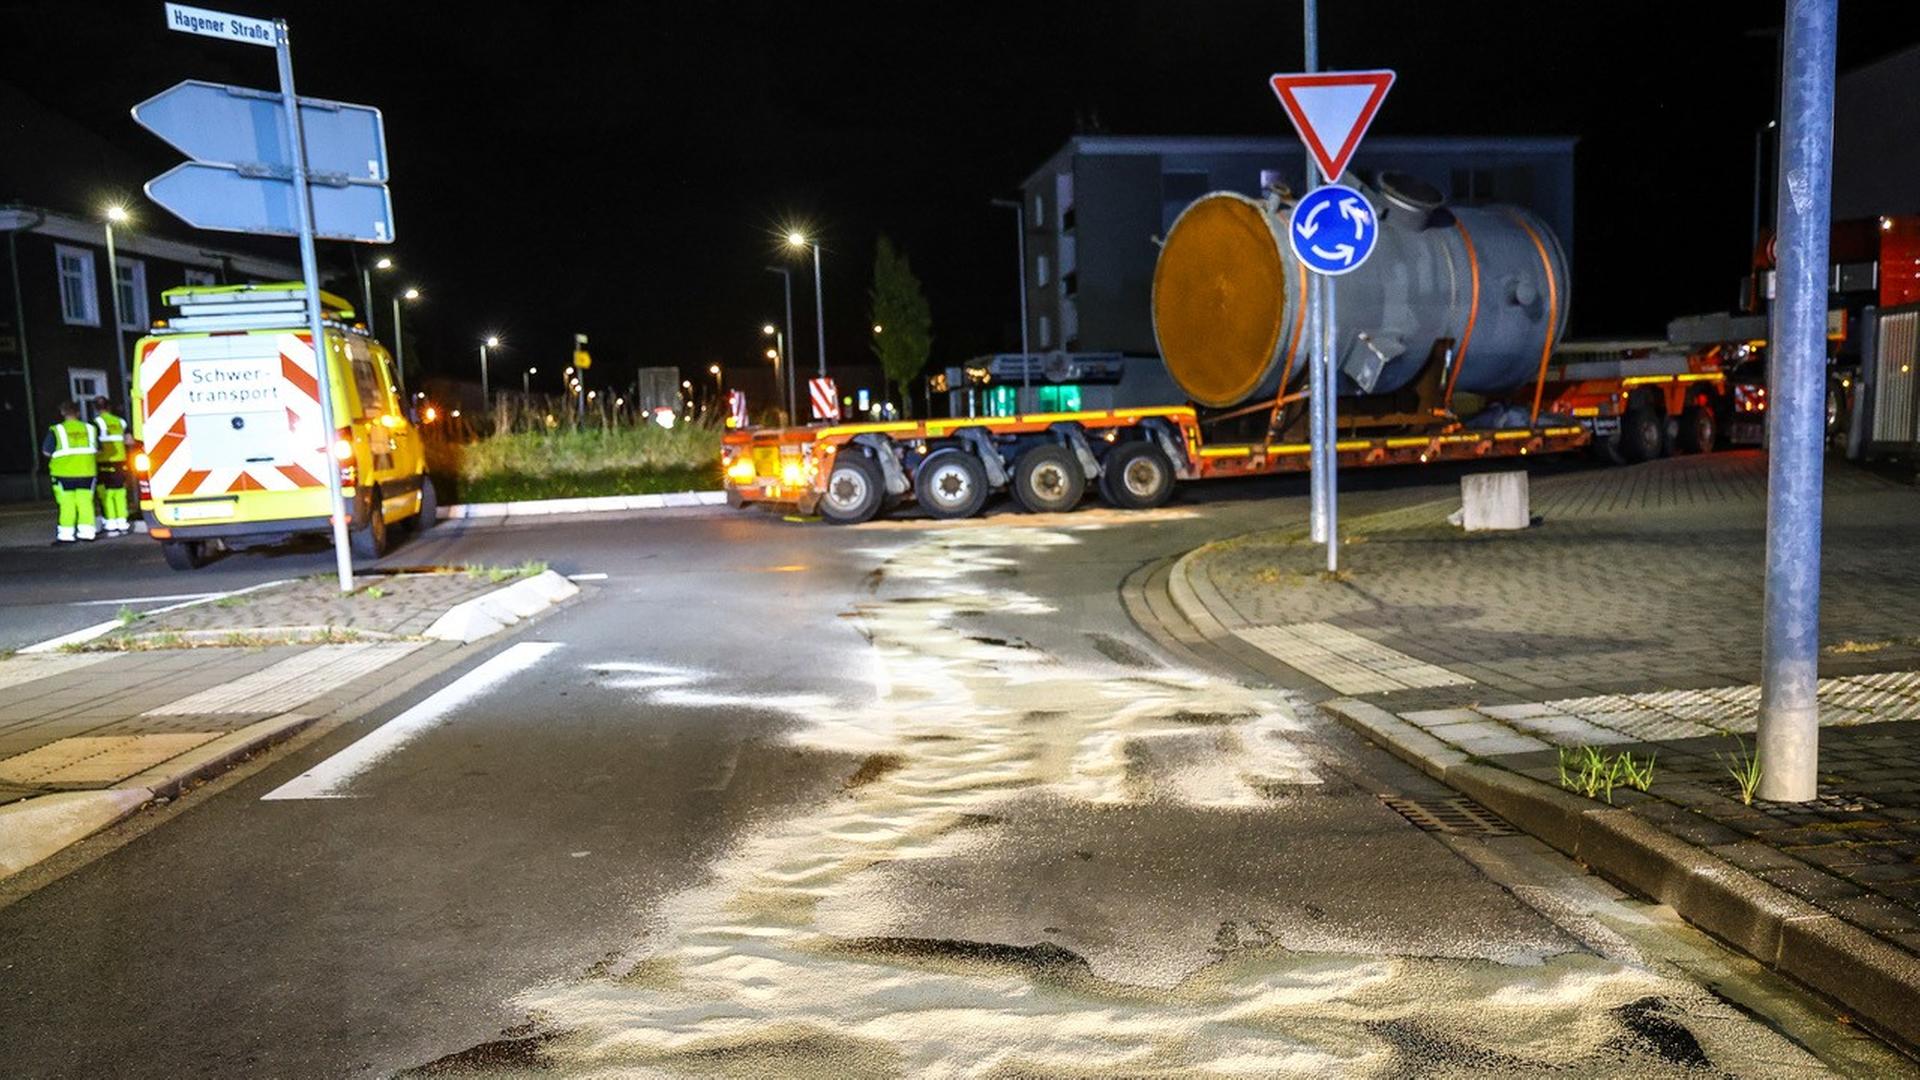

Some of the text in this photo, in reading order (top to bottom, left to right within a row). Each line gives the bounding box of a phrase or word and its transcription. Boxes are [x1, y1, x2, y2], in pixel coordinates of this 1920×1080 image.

[174, 9, 270, 40] Hagener Straße
[192, 368, 271, 384] Schwer-
[189, 387, 277, 403] transport
